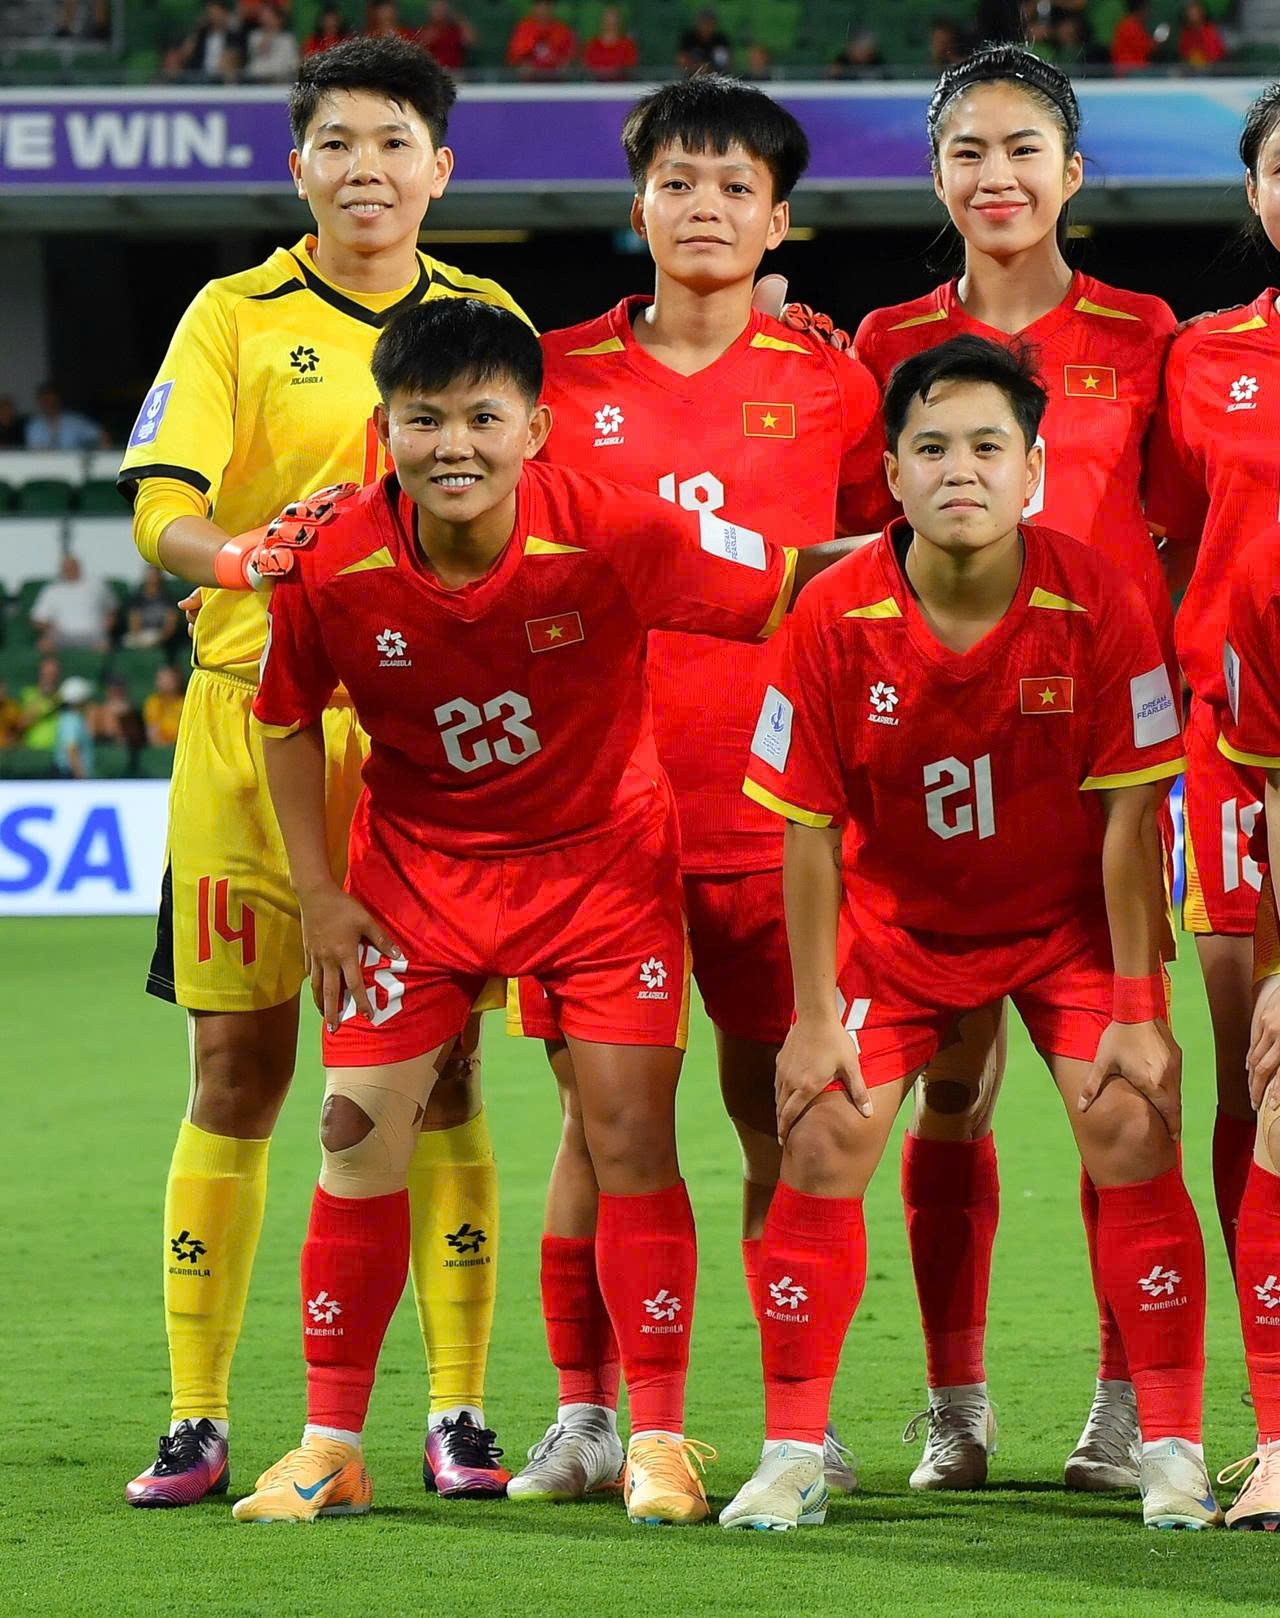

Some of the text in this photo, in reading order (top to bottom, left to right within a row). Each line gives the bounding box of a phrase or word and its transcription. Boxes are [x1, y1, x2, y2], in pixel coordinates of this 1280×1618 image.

[0, 111, 253, 170] E WIN.
[433, 690, 542, 773] 23
[923, 753, 996, 841] 21
[0, 806, 132, 892] SA
[196, 874, 257, 967] 14
